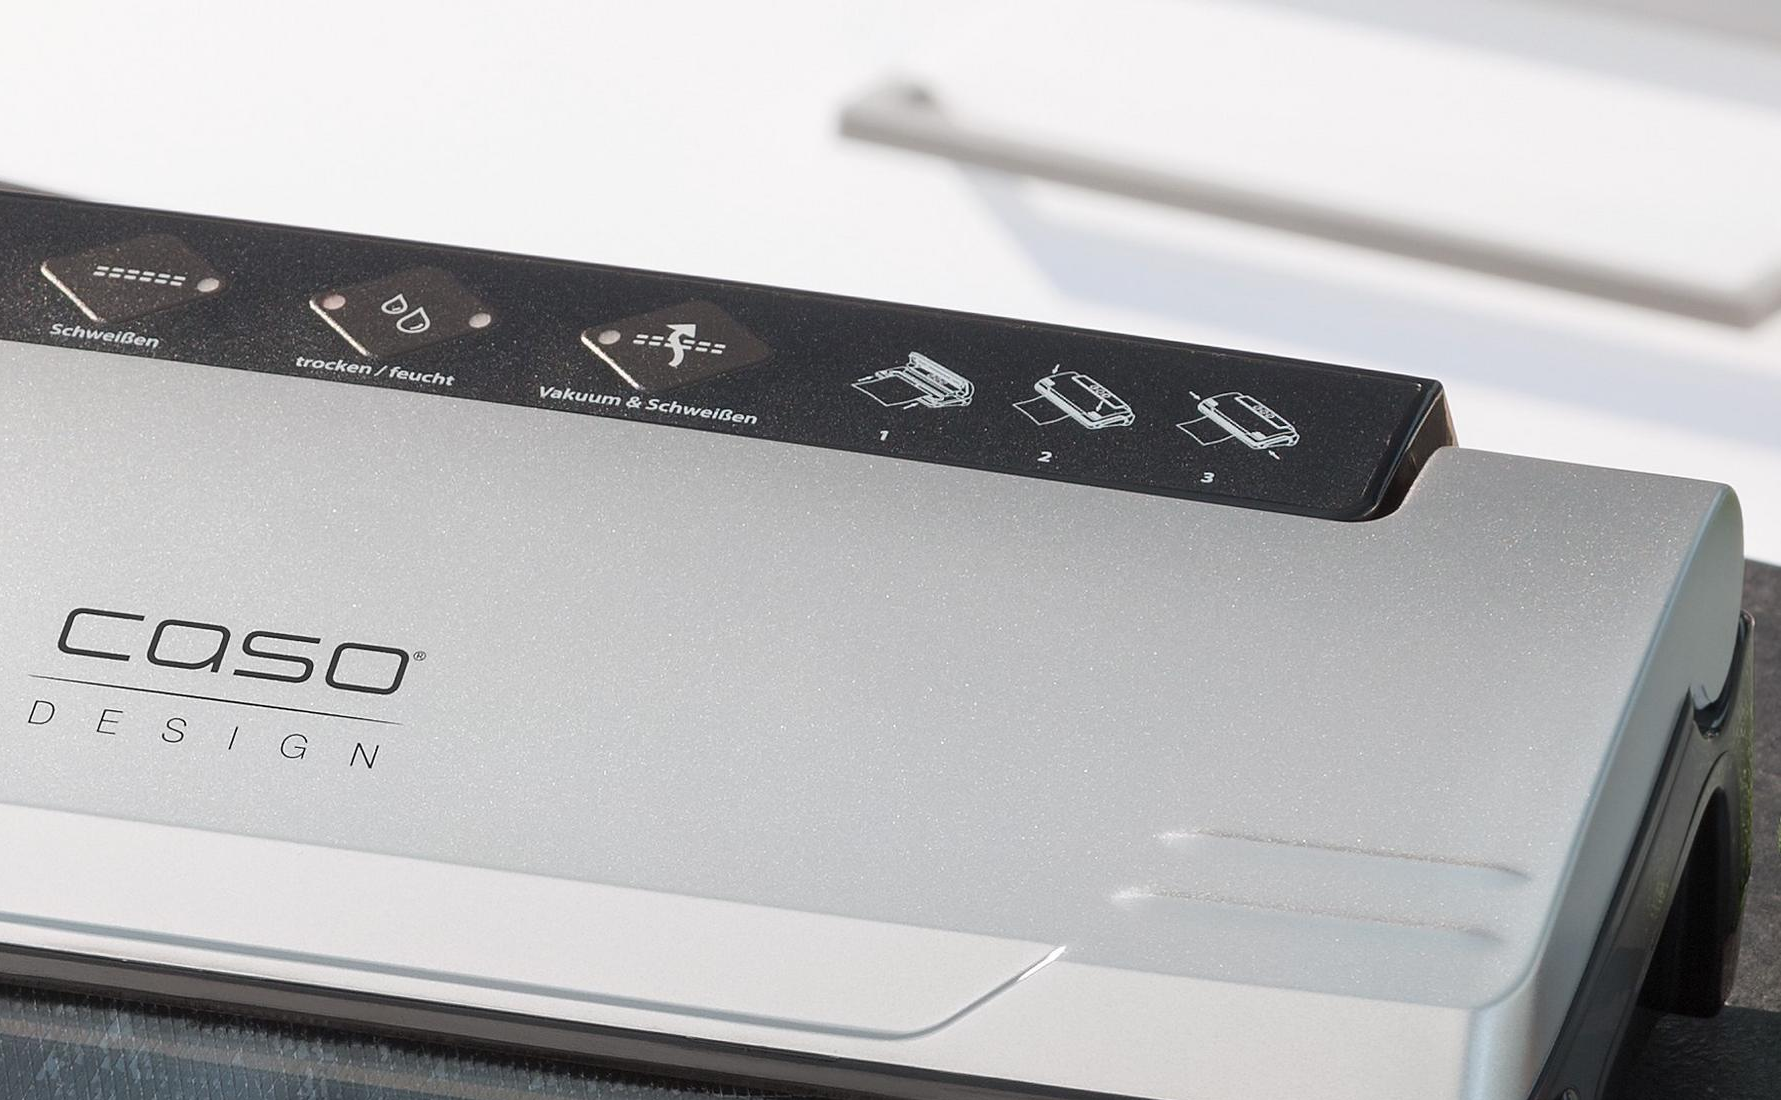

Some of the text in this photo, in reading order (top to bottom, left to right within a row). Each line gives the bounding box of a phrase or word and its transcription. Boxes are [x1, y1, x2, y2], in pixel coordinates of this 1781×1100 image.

[49, 323, 160, 349] Schweißen
[295, 356, 456, 387] trocken / feucht
[538, 385, 759, 425] Vakuum & Schweißen
[879, 430, 889, 441] 1
[1037, 451, 1053, 463] 2
[1200, 472, 1216, 484] 3
[26, 699, 381, 770] DESIGN
